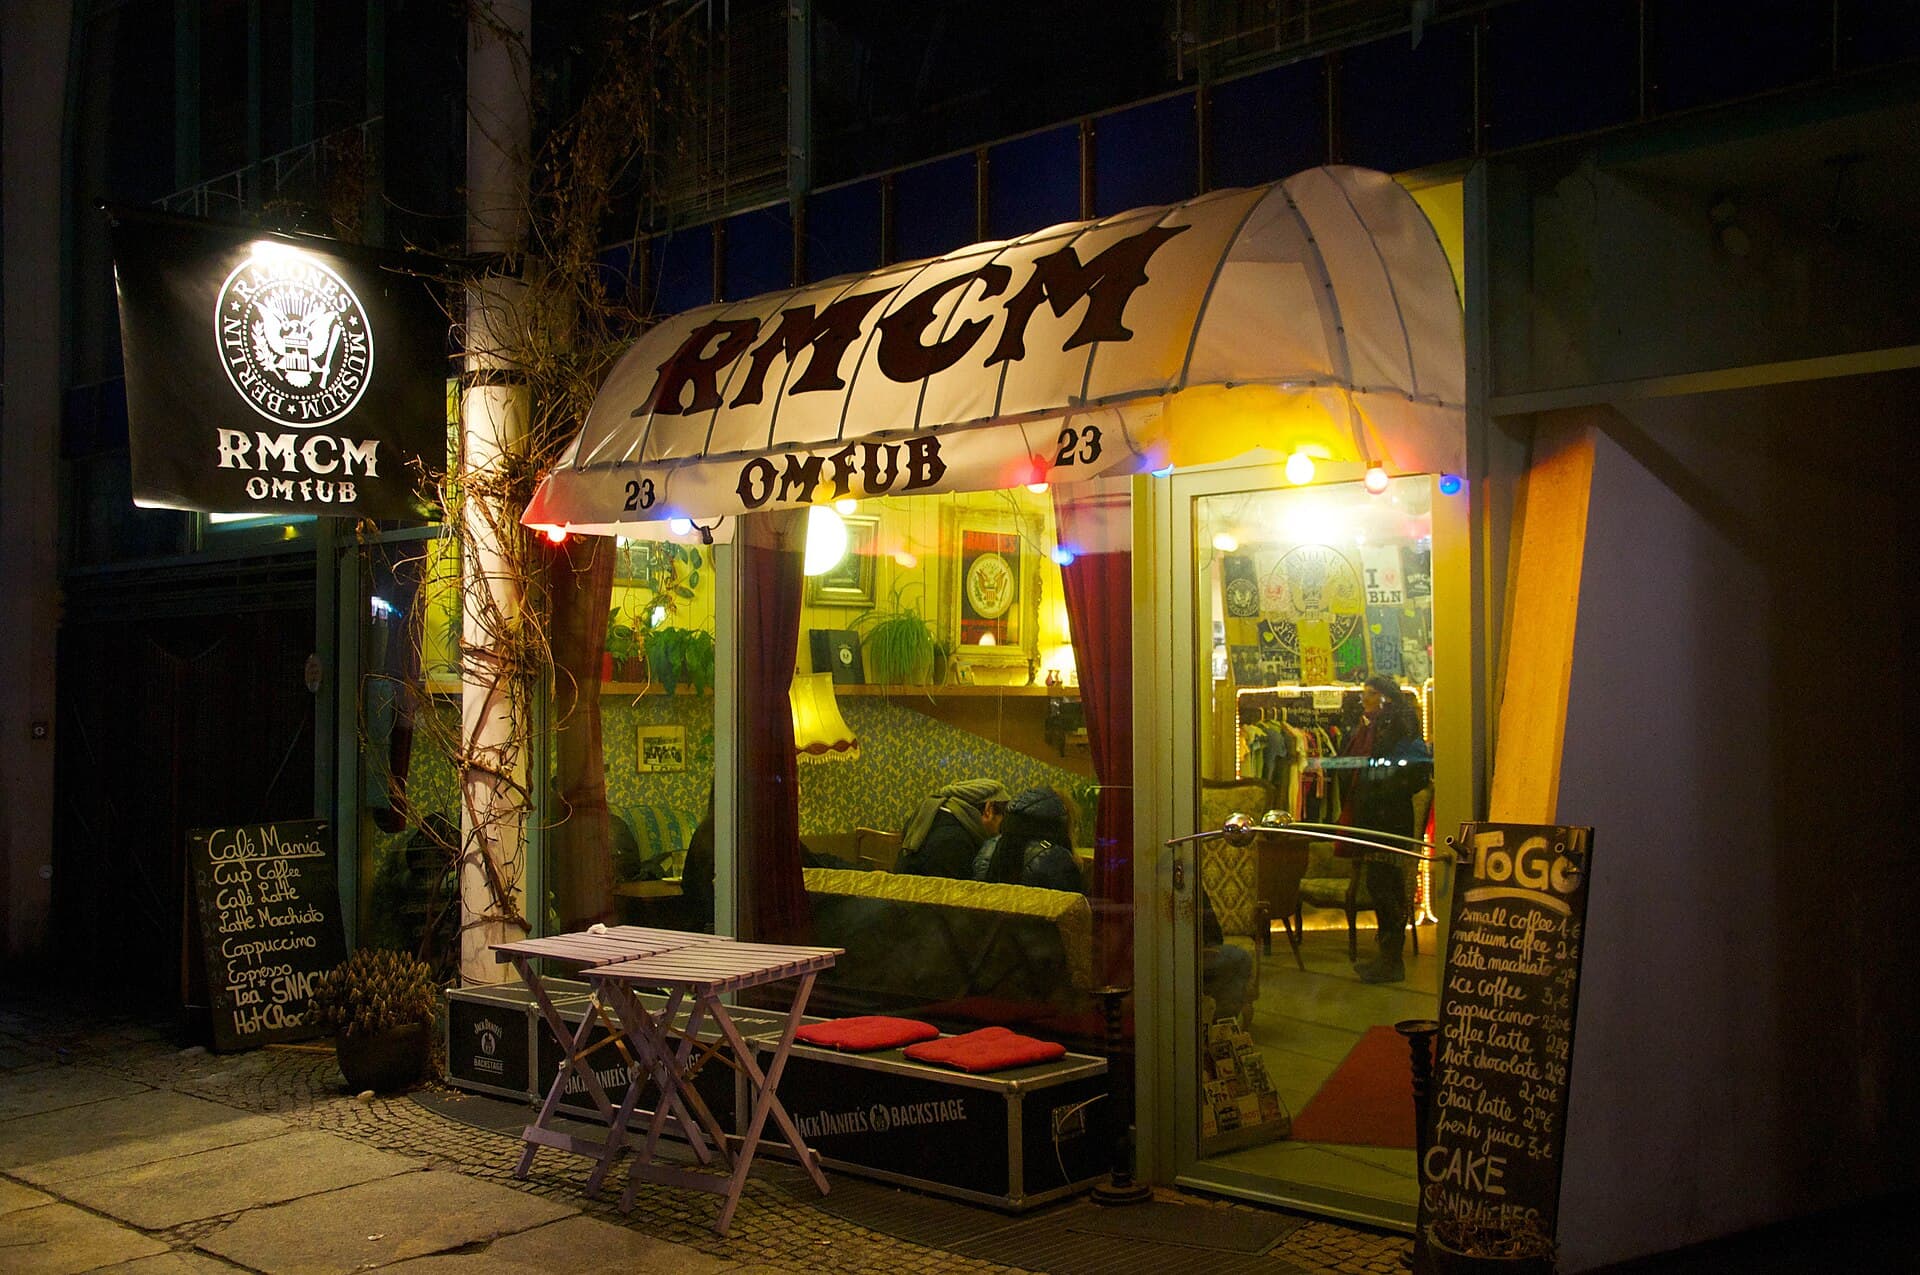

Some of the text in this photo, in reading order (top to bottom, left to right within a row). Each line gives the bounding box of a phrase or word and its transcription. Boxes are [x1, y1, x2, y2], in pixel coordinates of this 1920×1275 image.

[232, 260, 352, 313] RAMONES
[631, 224, 1191, 417] RMCM
[223, 315, 286, 415] BERLIN
[299, 331, 366, 419] MUSEUM
[216, 427, 380, 478] RMCM
[1055, 424, 1103, 467] 23
[245, 476, 358, 503] OMFUB
[736, 435, 948, 509] OMFUB
[623, 478, 656, 511] 23
[1366, 568, 1379, 589] I
[1367, 590, 1402, 604] BLN
[208, 824, 321, 870] Café Mania
[214, 859, 302, 895] Cup Coffee
[258, 880, 300, 903] Latte
[218, 903, 325, 933] Latte Macchiato
[1459, 906, 1508, 927] small
[1509, 908, 1557, 942] coffee
[222, 930, 317, 966] Cappuccino
[1449, 943, 1488, 971] latte
[1488, 955, 1557, 976] macchiato
[1453, 928, 1509, 948] medium
[1509, 931, 1552, 962] coffee
[227, 959, 293, 989] Espresso
[1448, 969, 1475, 994] ice
[1477, 975, 1528, 1008] coffee
[226, 983, 265, 1008] Tea
[233, 1005, 263, 1036] Hot
[1444, 1023, 1485, 1048] coffee
[1486, 1022, 1535, 1054] latte
[1440, 1041, 1473, 1068] hot
[1473, 1047, 1543, 1081] chocolate
[1442, 1066, 1484, 1091] tea
[793, 1098, 968, 1139] JACK DANIEL'S BACKSTAGE
[1437, 1085, 1473, 1112] chai
[1475, 1089, 1517, 1123] latte
[1435, 1108, 1481, 1145] fresh
[1482, 1122, 1526, 1155] juice
[1423, 1144, 1508, 1196] CAKE
